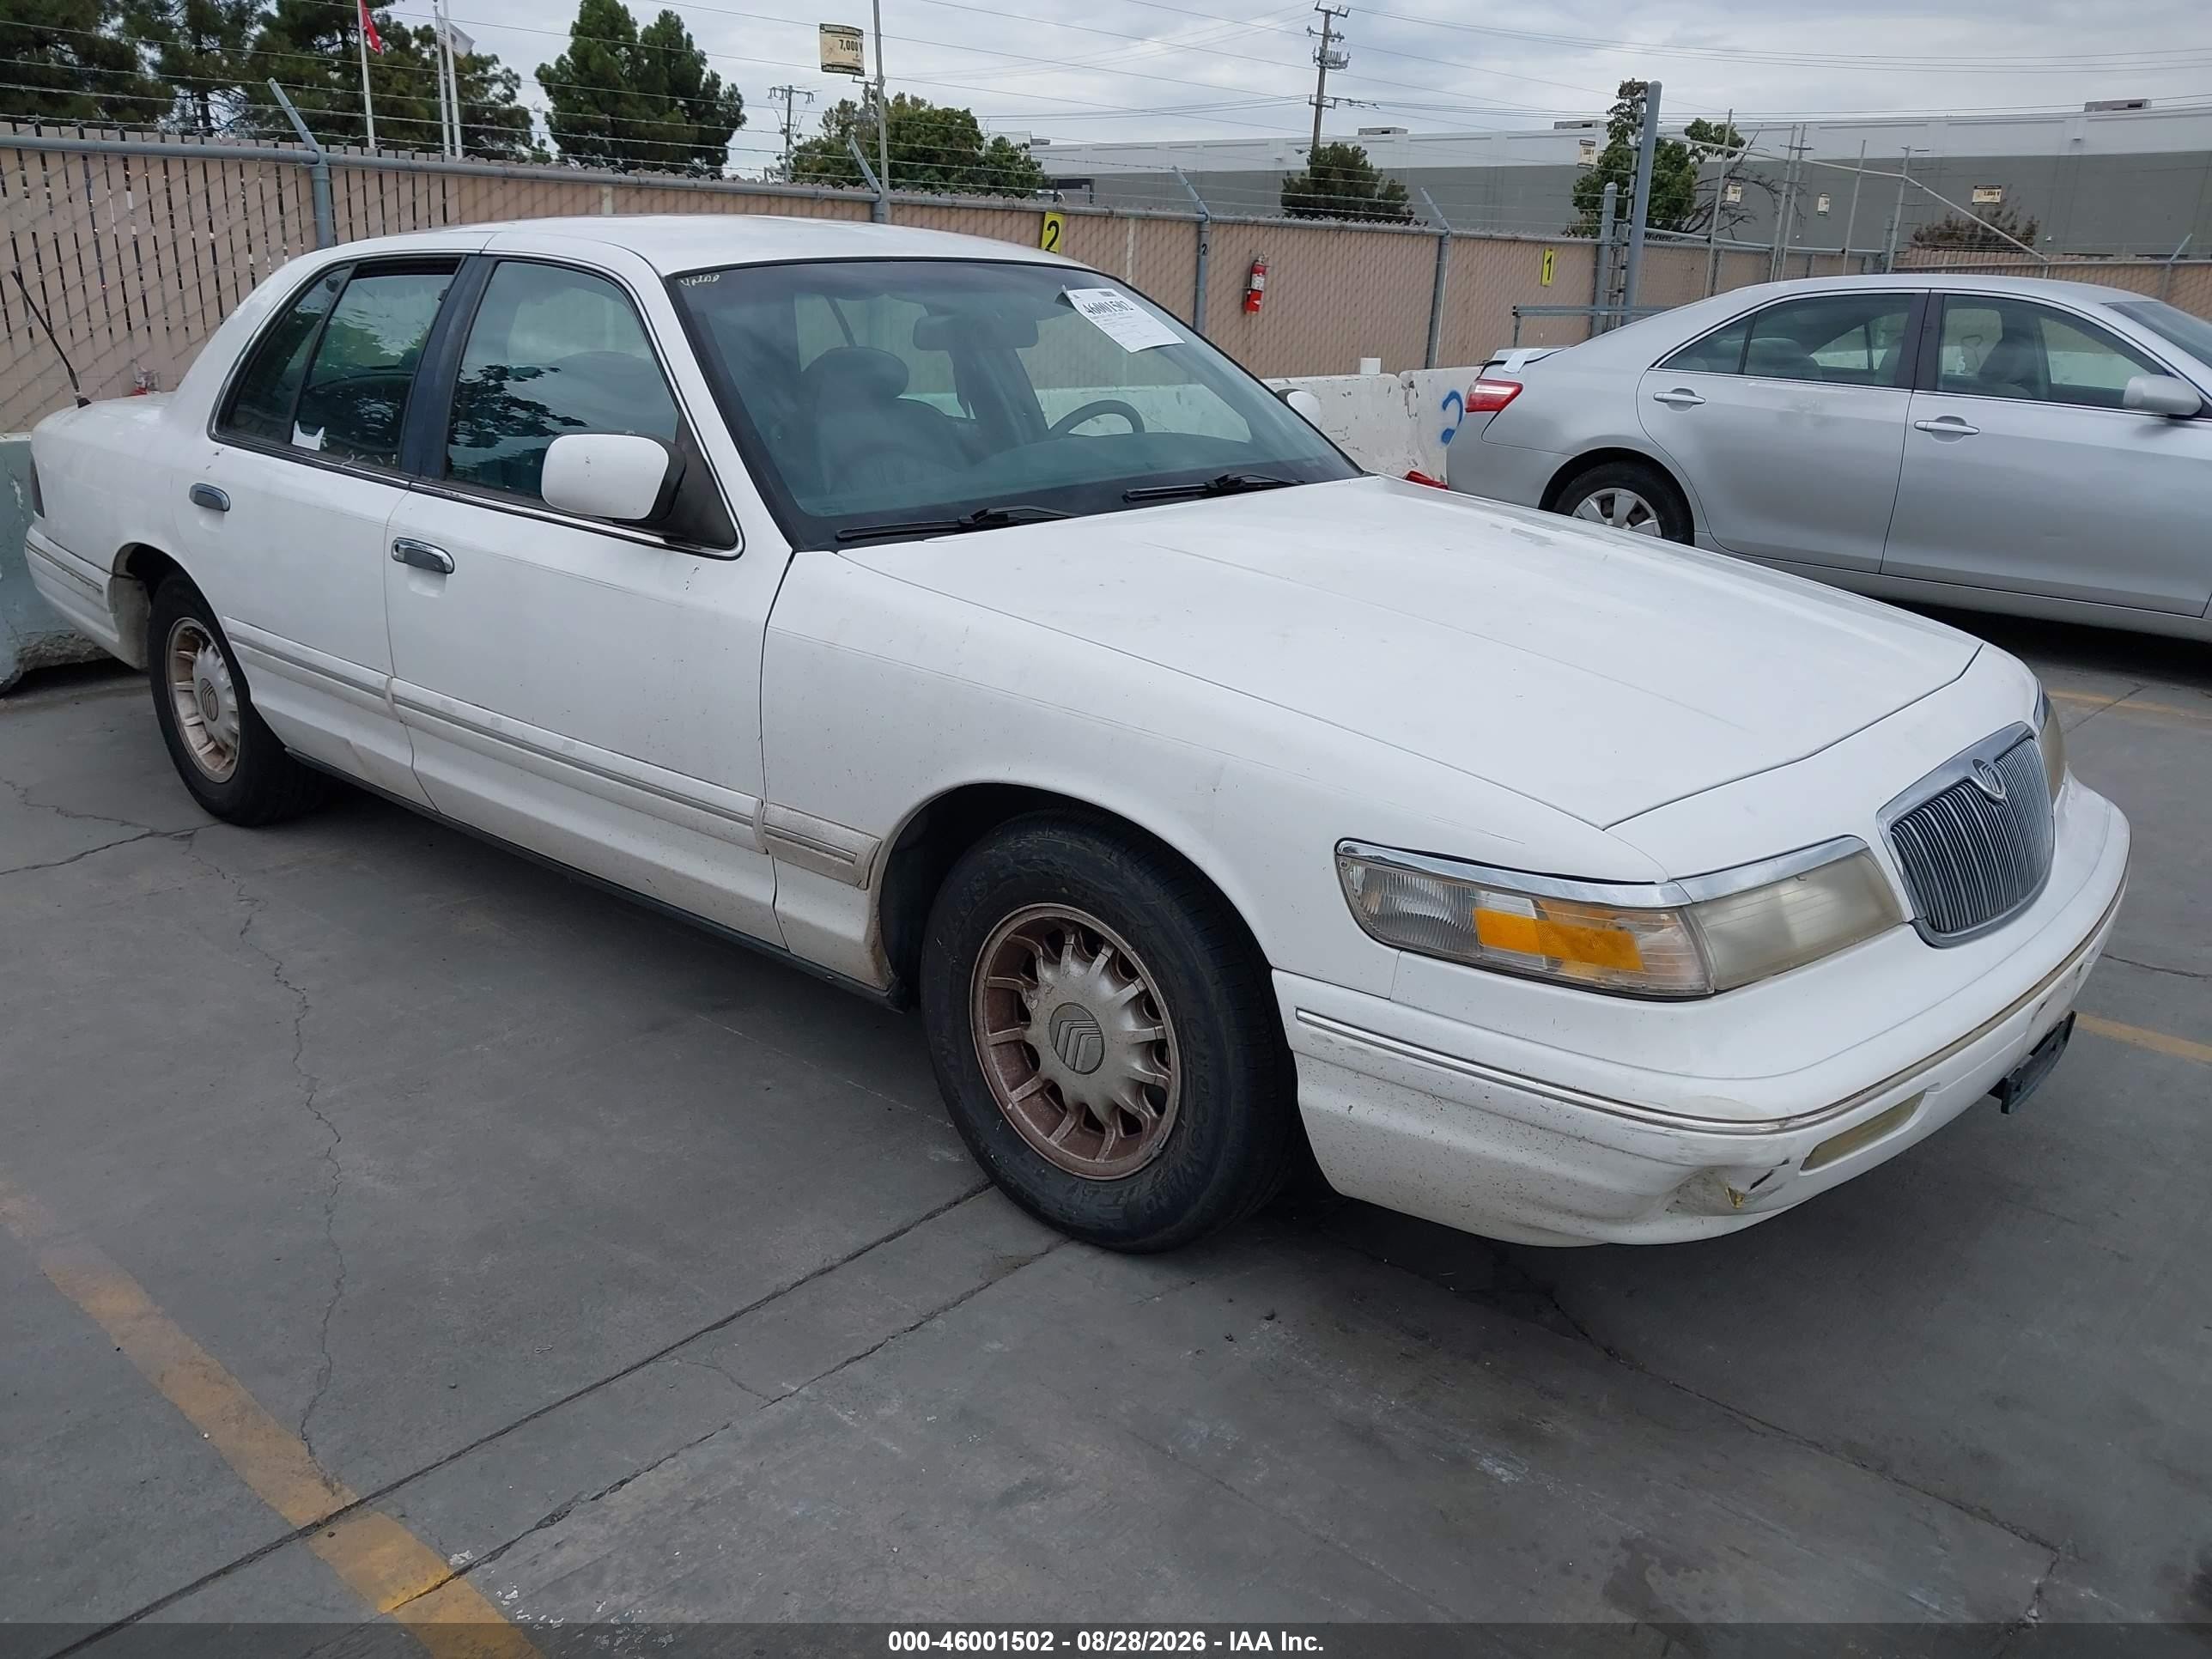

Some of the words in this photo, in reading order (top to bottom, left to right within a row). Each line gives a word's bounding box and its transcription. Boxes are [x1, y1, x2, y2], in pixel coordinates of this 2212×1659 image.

[839, 40, 858, 52] 7,000
[1044, 220, 1060, 253] 2
[1546, 254, 1553, 281] 1
